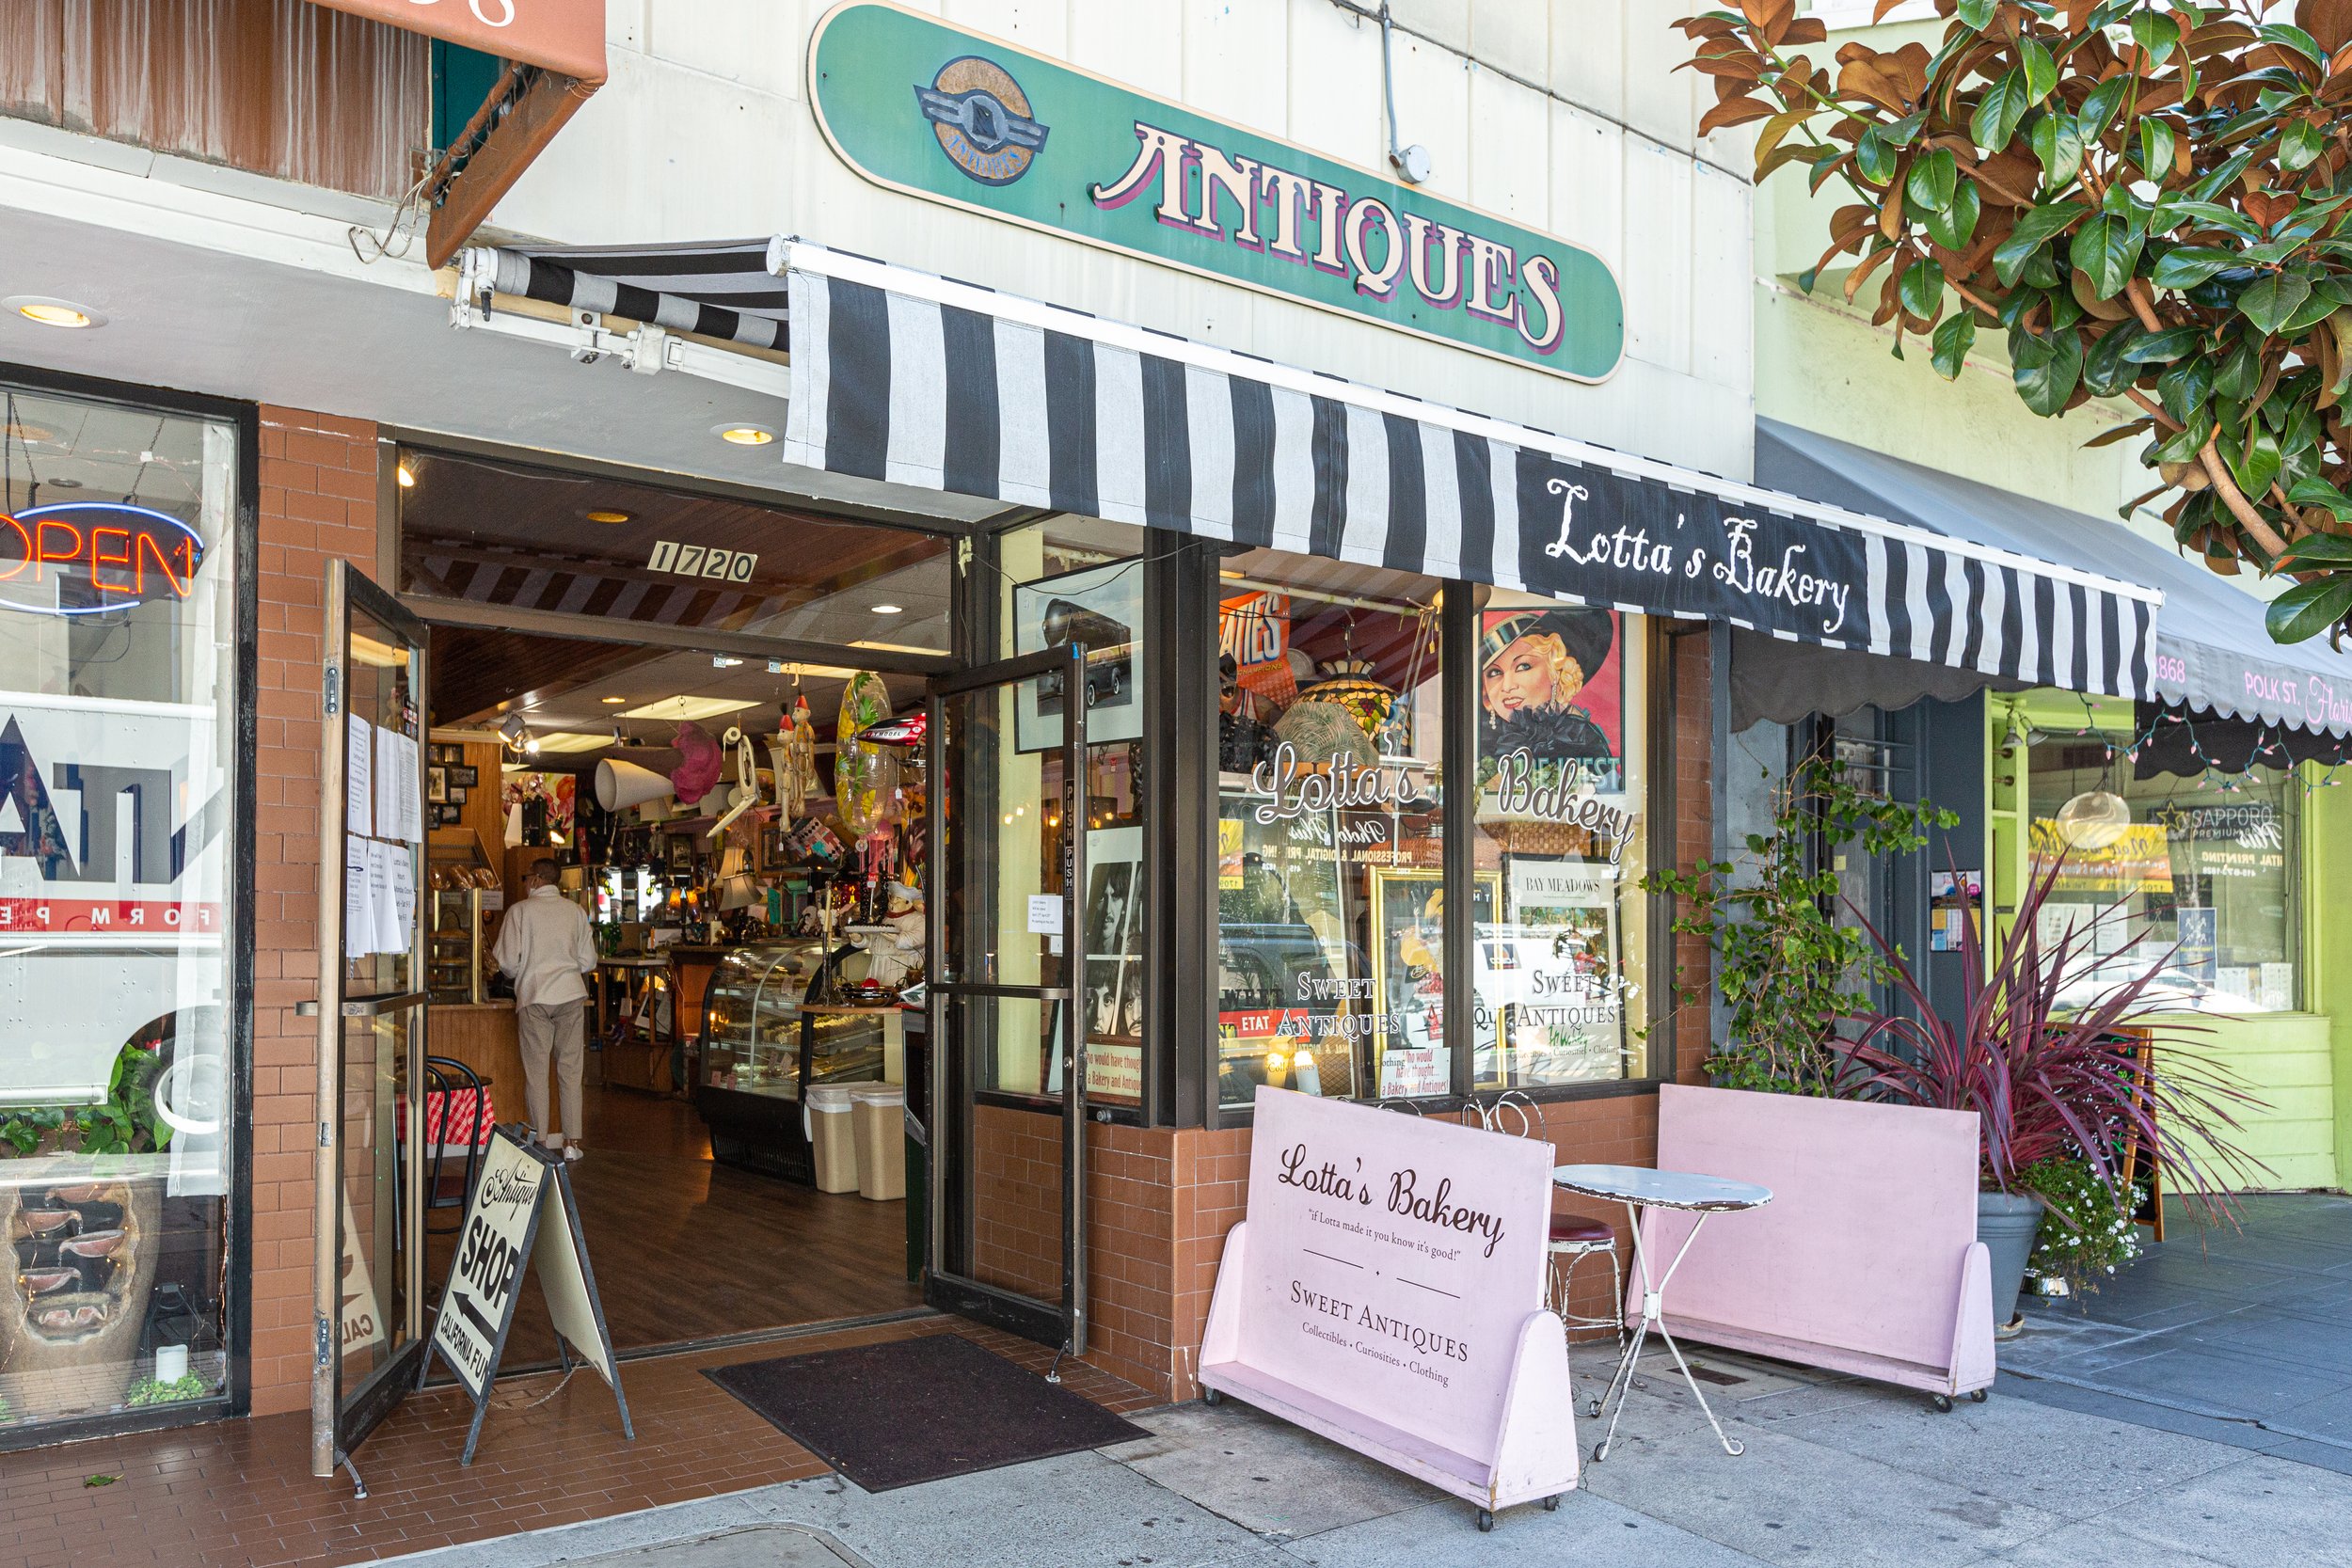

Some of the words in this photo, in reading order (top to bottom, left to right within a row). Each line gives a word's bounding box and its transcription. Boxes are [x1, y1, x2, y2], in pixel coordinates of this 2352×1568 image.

[1087, 119, 1565, 355] ANTIQUES
[656, 544, 753, 580] 1720
[1545, 478, 1707, 578] Lotta's
[1712, 516, 1850, 633] Bakery
[1219, 593, 1280, 664] ATIES
[2155, 656, 2185, 684] 868
[2244, 669, 2280, 702] POLK
[2281, 680, 2301, 705] ST.
[2305, 675, 2352, 724] Flori
[1252, 731, 1418, 825] Lotta's
[1498, 746, 1635, 864] Bakery
[2192, 806, 2272, 828] SAPPORO
[1526, 877, 1544, 892] BAY
[1548, 878, 1600, 893] MEADOWS
[1297, 971, 1376, 1001] SWEET
[1532, 970, 1597, 994] SWEET
[1241, 1016, 1270, 1031] ETAT
[1275, 1007, 1400, 1043] ANTIQUES
[1517, 1002, 1616, 1031] ANTIQUES
[1094, 1052, 1110, 1066] would
[1111, 1053, 1123, 1068] have
[1124, 1054, 1141, 1073] thoug
[1416, 1049, 1433, 1063] would
[1593, 1044, 1619, 1055] Clothing
[1091, 1070, 1110, 1090] Bakery
[1111, 1074, 1121, 1088] and
[1387, 1083, 1407, 1097] Bakery
[1422, 1079, 1449, 1094] Antiques!
[1278, 1143, 1373, 1205] Lotta's
[1388, 1168, 1504, 1259] Bakery
[1319, 1212, 1341, 1228] Lotta
[1342, 1219, 1364, 1235] made
[1365, 1226, 1373, 1237] it
[1374, 1231, 1390, 1243] you
[1391, 1233, 1415, 1249] know
[1417, 1241, 1429, 1254] it's
[460, 1214, 520, 1309] SHOP
[440, 1311, 473, 1365] CALIFORNIA
[1291, 1280, 1353, 1321] SWEET
[1358, 1305, 1469, 1362] ANTIQUES
[1302, 1322, 1347, 1347] Collectibles
[1355, 1340, 1401, 1368] Curiosities
[1409, 1360, 1450, 1388] Clothing
